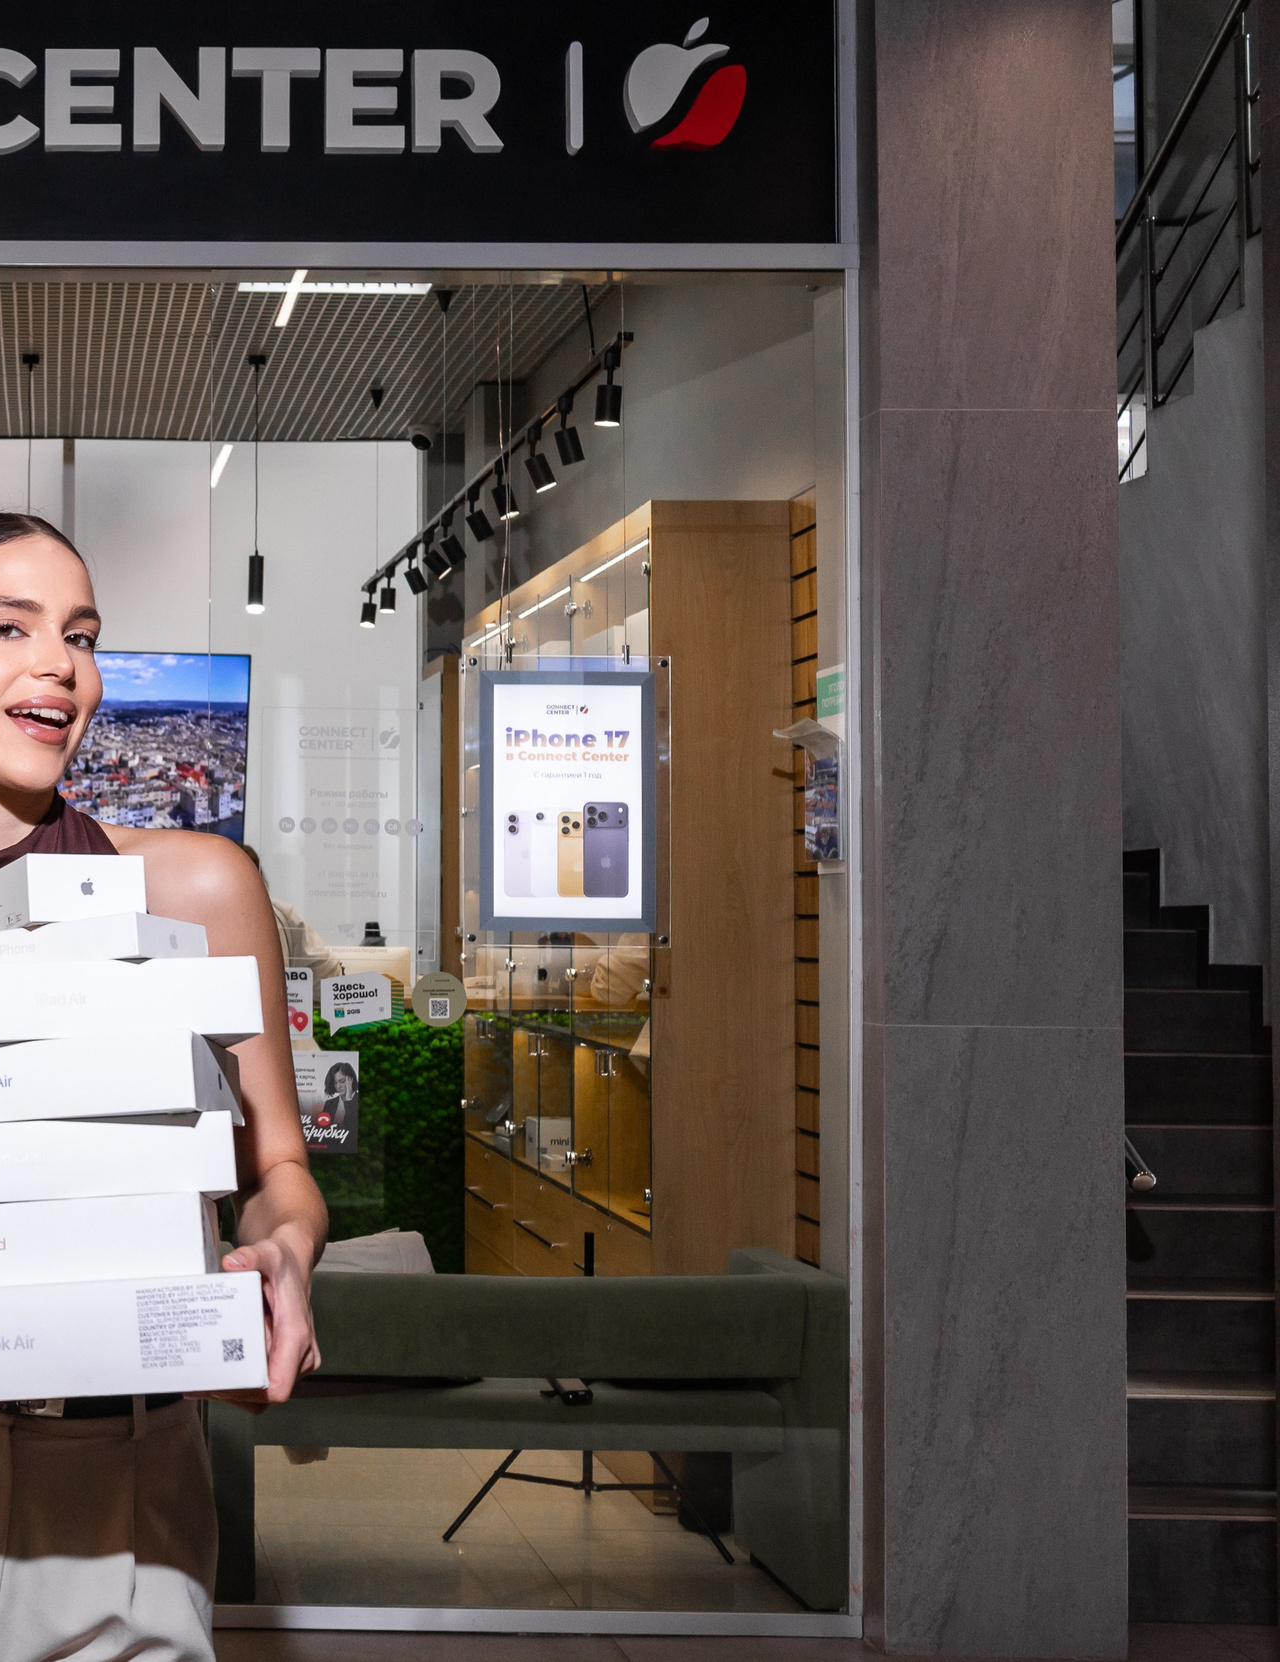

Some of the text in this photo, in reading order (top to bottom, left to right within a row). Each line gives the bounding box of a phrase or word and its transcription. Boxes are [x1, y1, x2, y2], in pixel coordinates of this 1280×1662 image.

[298, 726, 368, 738] CONNECT
[505, 726, 630, 748] iPhone 17
[298, 738, 354, 751] CENTER
[505, 751, 630, 762] в Connect Center
[533, 771, 541, 779] С
[540, 770, 583, 780] гарантией
[588, 772, 602, 781] год
[309, 788, 389, 801] Режим работы
[281, 821, 293, 829] Пн
[387, 822, 398, 831] Сб
[332, 982, 366, 993] Здесь
[68, 990, 88, 1006] Air
[332, 988, 379, 1002] хорошо!
[346, 1008, 361, 1016] 2GIS
[550, 1136, 570, 1146] mini
[135, 1286, 185, 1295] MANUFACTURED
[136, 1293, 168, 1301] IMPORTED
[177, 1290, 195, 1298] APPLE
[136, 1294, 235, 1308] CUSTOMER SUPPORT TELEPHONE
[136, 1311, 171, 1320] CUSTOMER
[171, 1309, 200, 1317] SUPPORT
[138, 1320, 218, 1332] COUNTRY OF ORIGIN CHINA
[13, 1334, 36, 1351] Air
[154, 1348, 174, 1356] OTHER
[174, 1346, 202, 1355] RELATED
[142, 1359, 185, 1369] SCAN QR CODE
